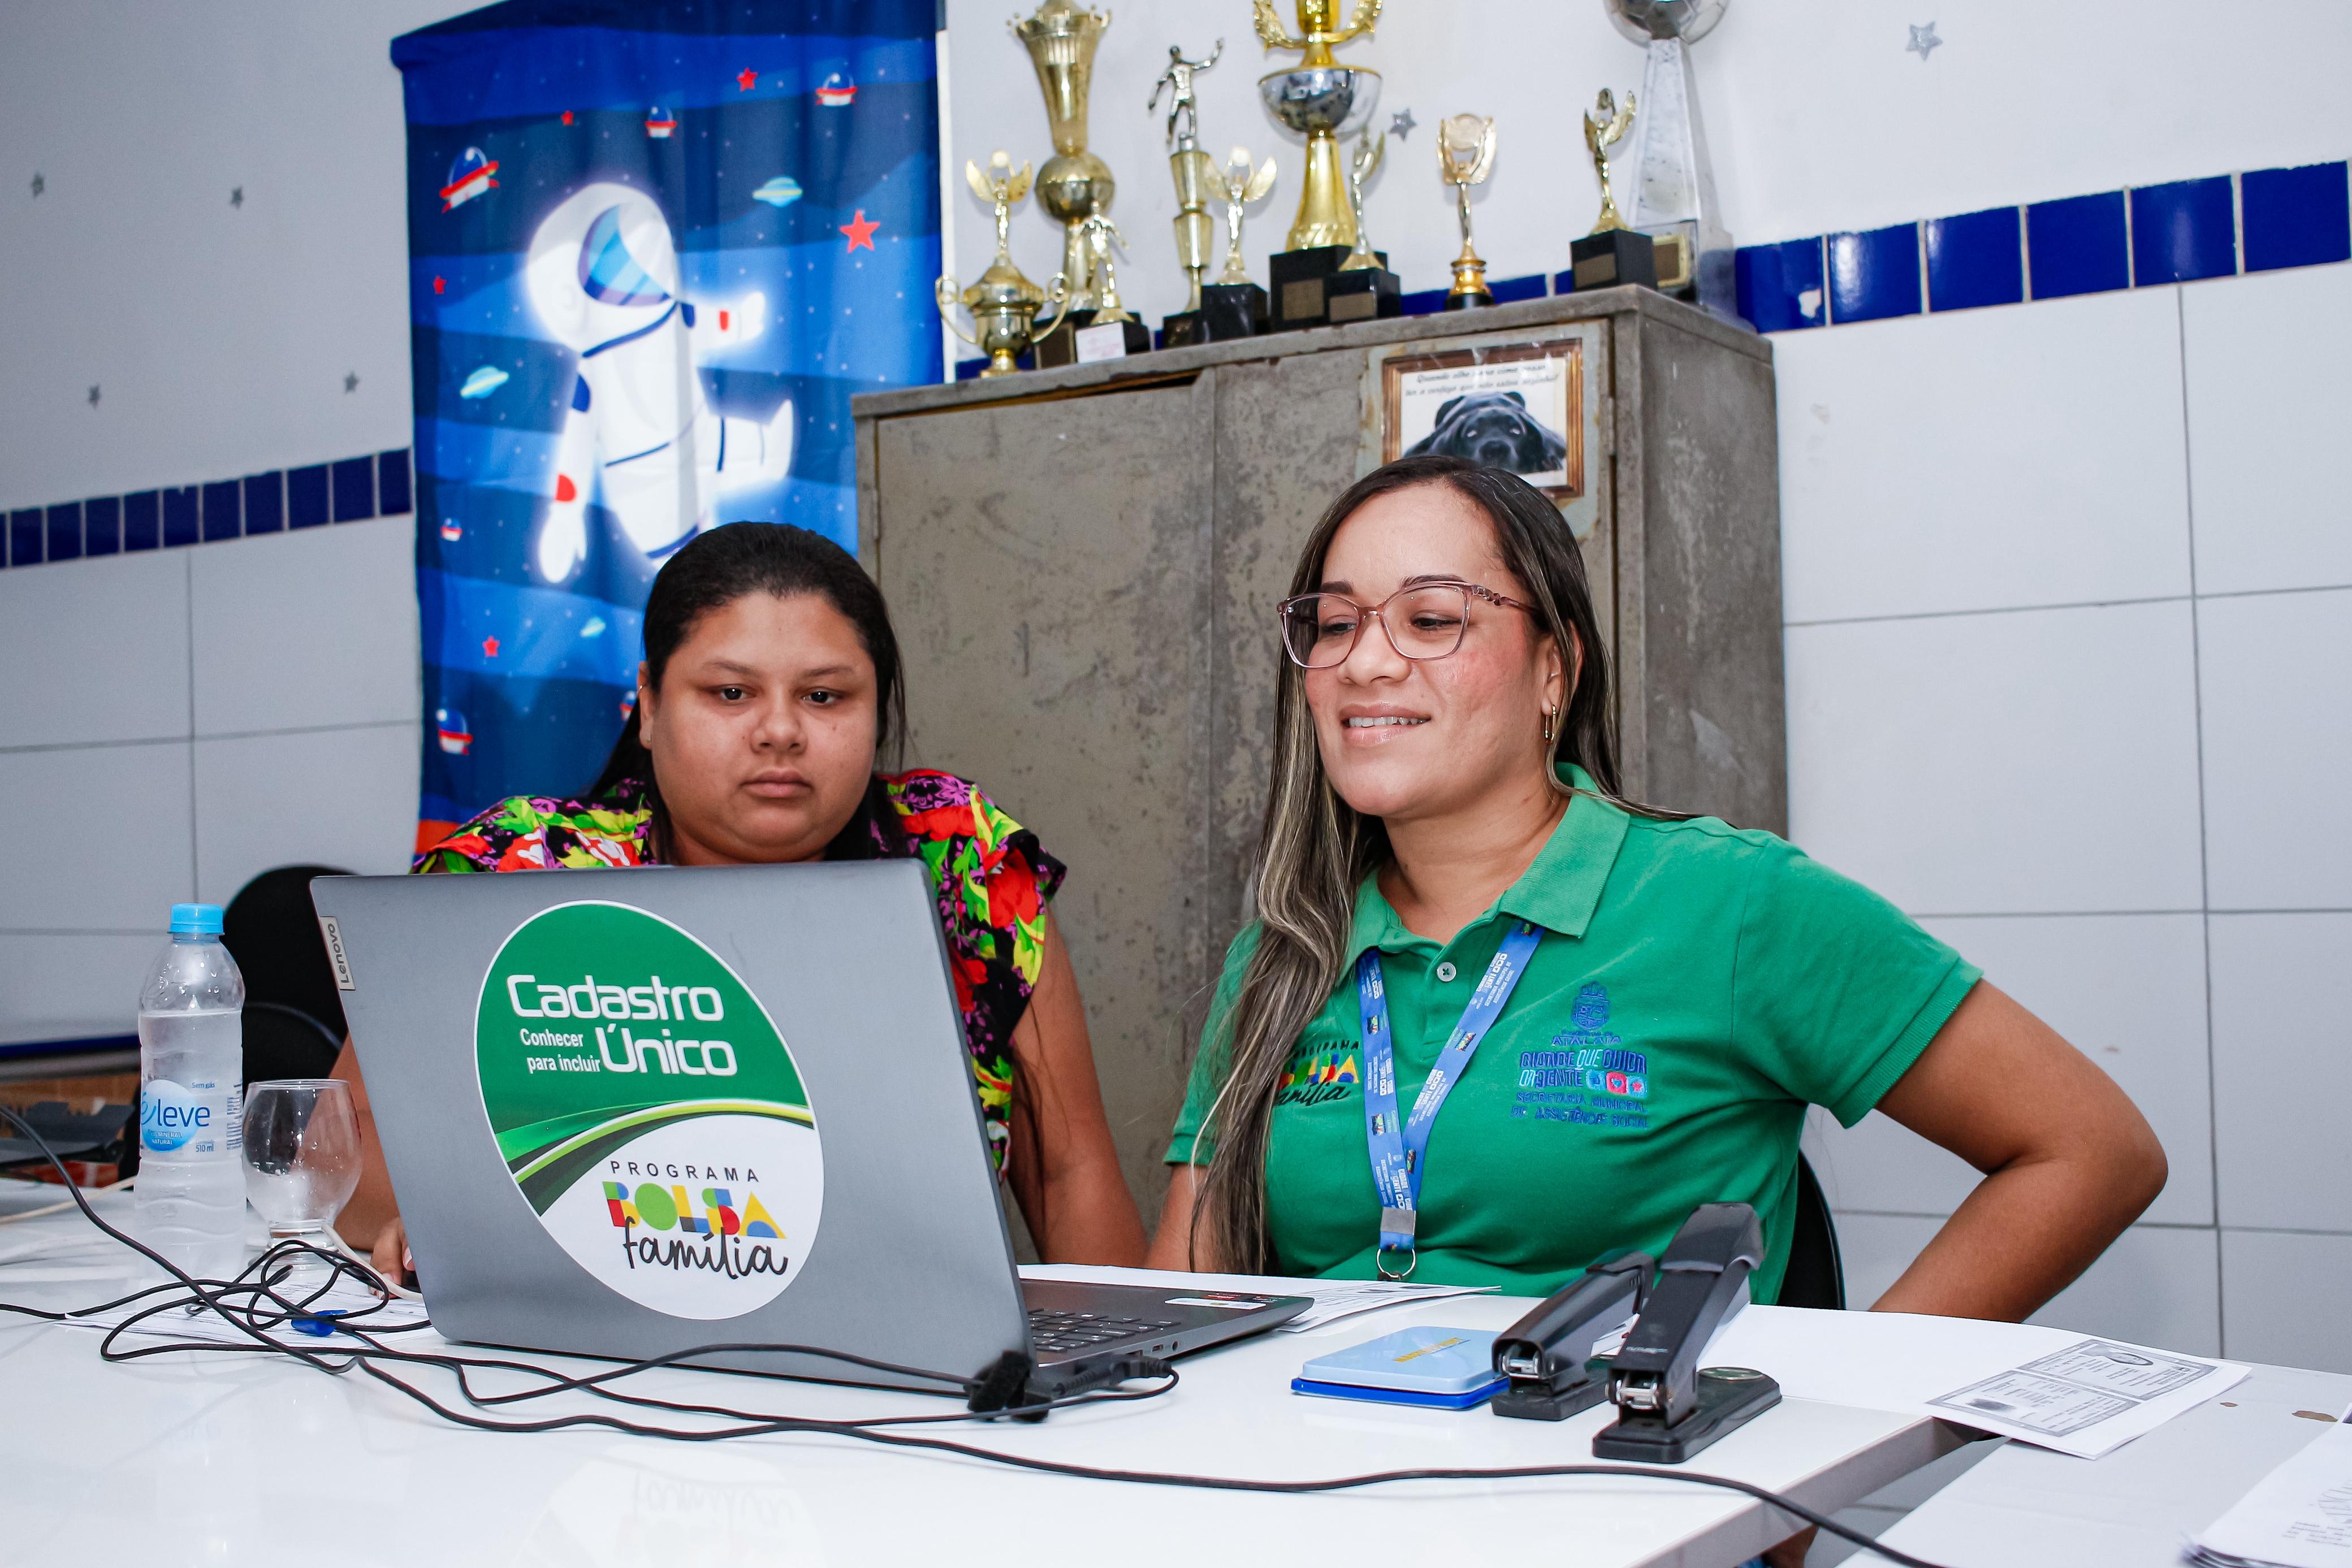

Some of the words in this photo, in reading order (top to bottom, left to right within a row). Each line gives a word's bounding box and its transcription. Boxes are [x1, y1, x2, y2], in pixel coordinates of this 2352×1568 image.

[328, 923, 349, 983] Lenovo
[506, 973, 725, 1022] Cadastro
[520, 1028, 584, 1048] Conhecer
[1551, 1036, 1622, 1046] ATALAIA
[595, 1024, 738, 1076] Único
[1576, 1049, 1603, 1070] QUE
[527, 1056, 558, 1074] para
[559, 1054, 601, 1073] incluir
[1516, 1091, 1586, 1104] SECRETARIA
[1592, 1096, 1649, 1112] MUNICIPAL
[1511, 1106, 1527, 1117] DE
[1612, 1114, 1650, 1128] SOCIAL
[206, 1143, 214, 1152] ml
[610, 1160, 760, 1183] PROGRAMA
[602, 1181, 787, 1238] BOLSA
[622, 1215, 790, 1279] família
